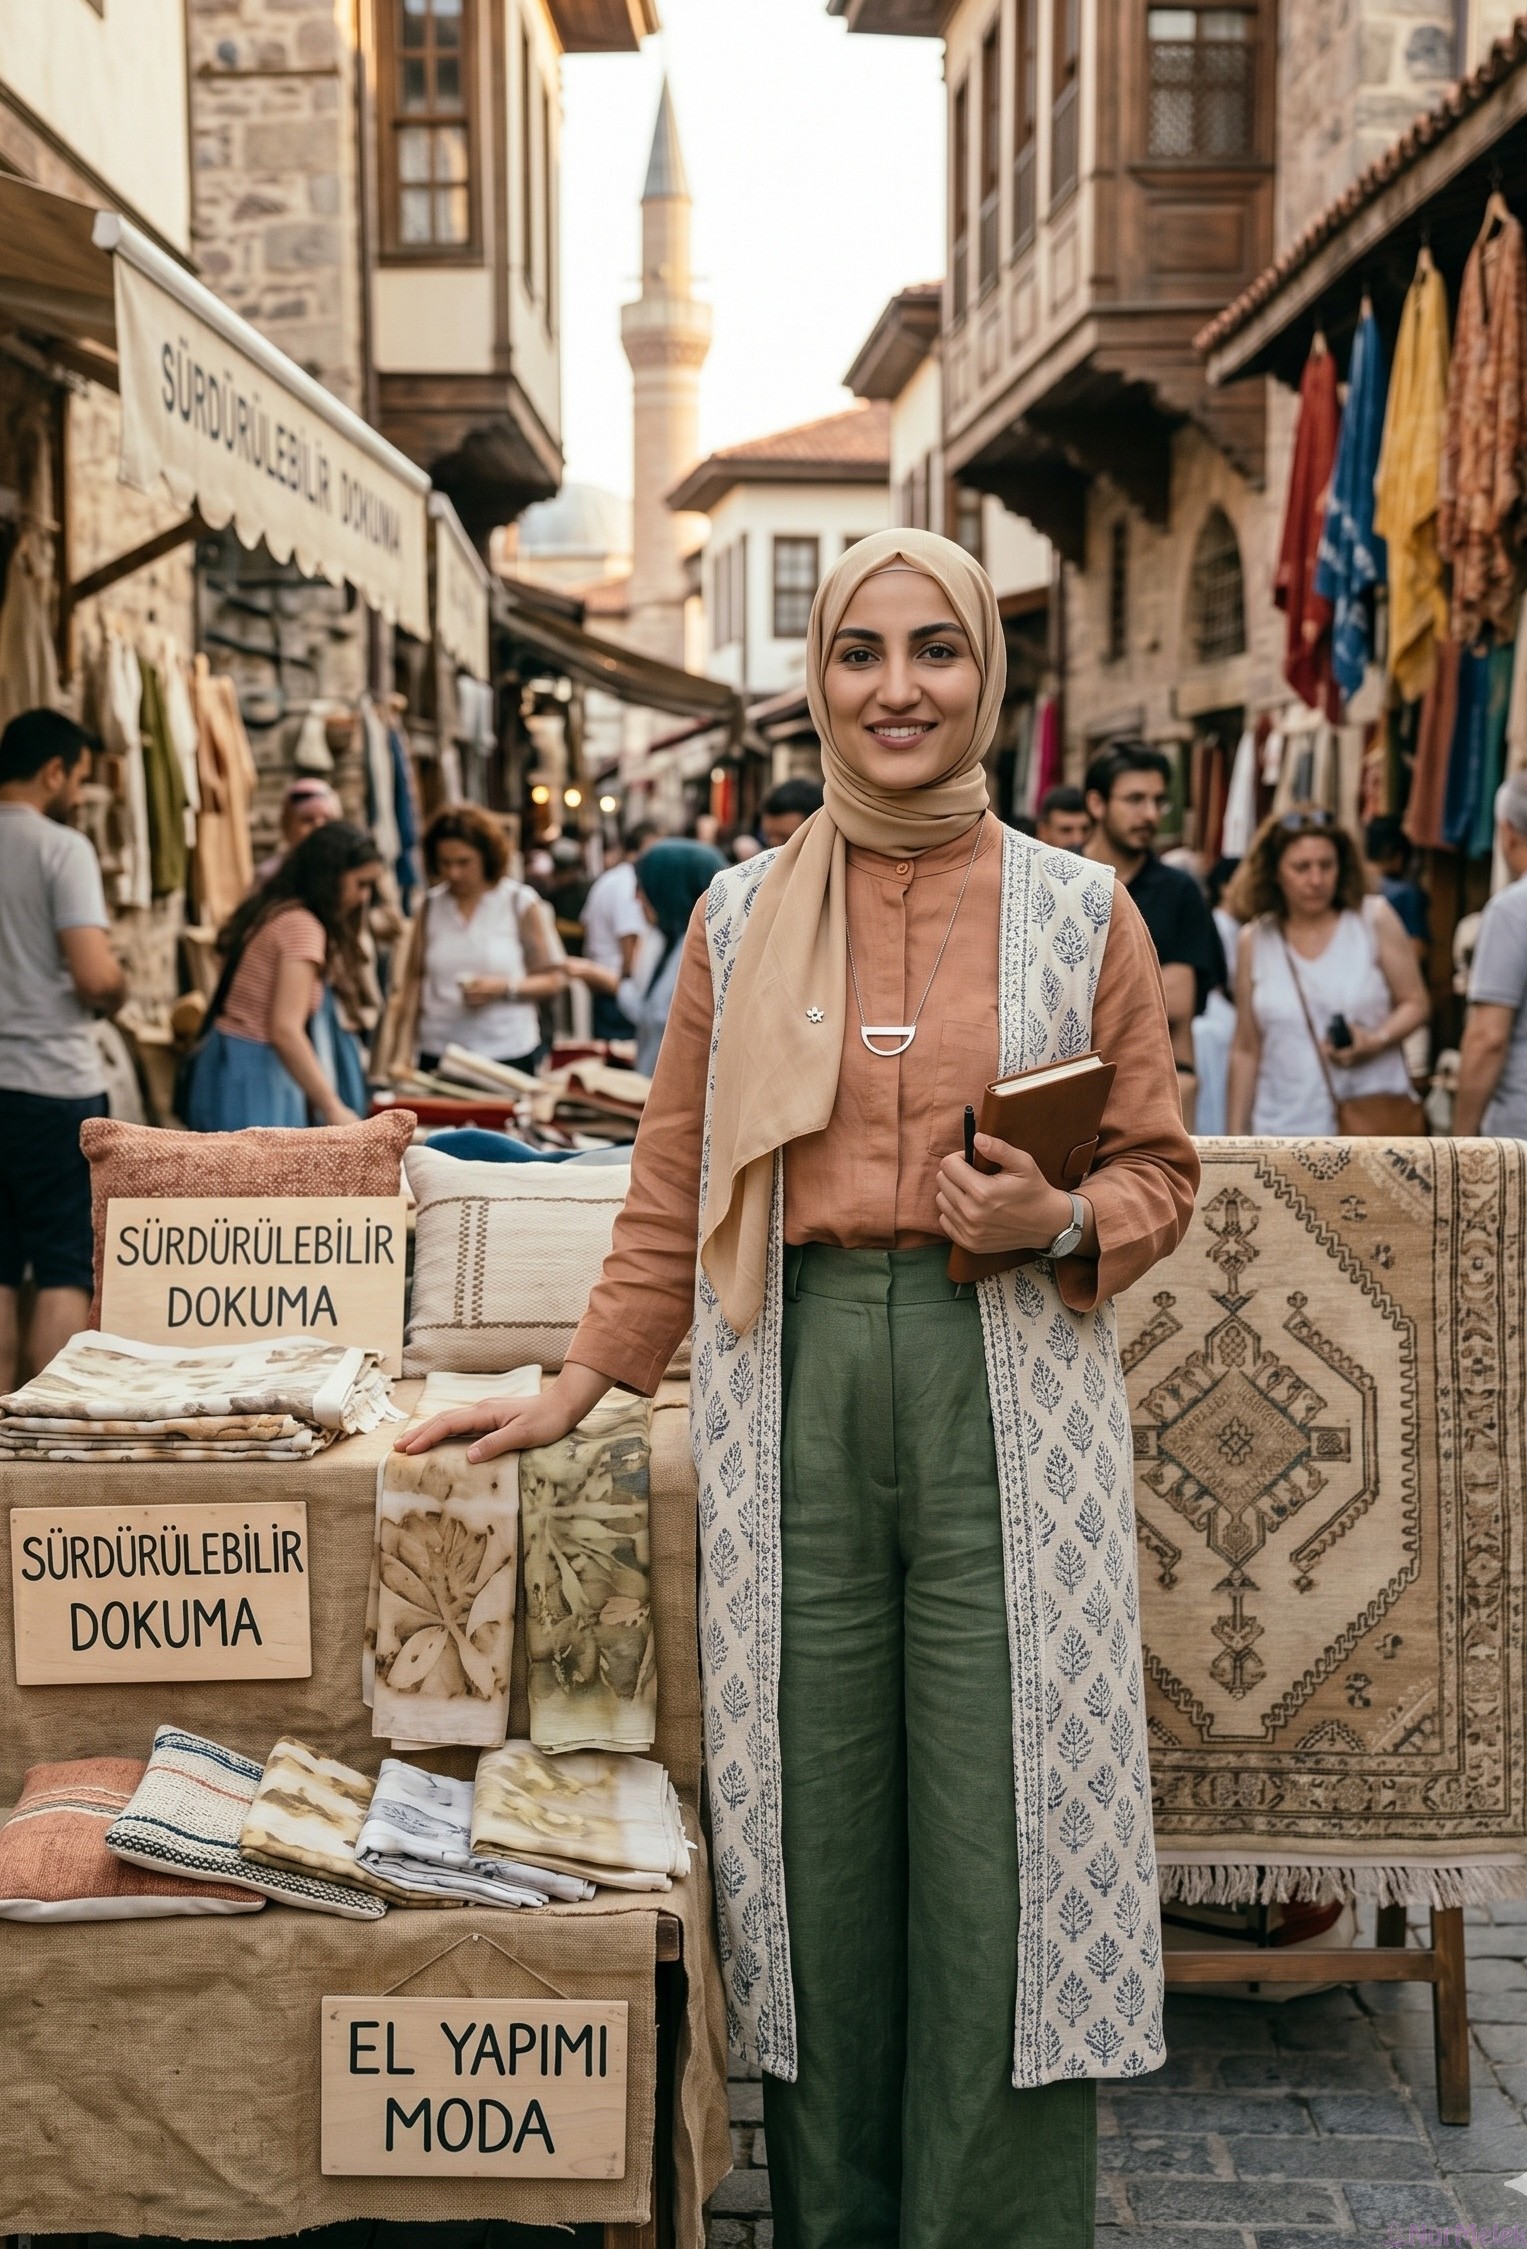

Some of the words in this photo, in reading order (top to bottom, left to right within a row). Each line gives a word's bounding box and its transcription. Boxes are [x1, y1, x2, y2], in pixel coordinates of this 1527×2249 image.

[161, 335, 332, 515] SÜRDÜRÜLEBİLİR
[116, 1217, 395, 1267] SÜRDÜRÜLEBİLİR
[167, 1285, 338, 1328] DOKUMA
[21, 1523, 304, 1582] SÜRDÜRÜLEBİLİR
[70, 1597, 263, 1651] DOKUMA
[349, 2021, 415, 2075] EL
[440, 2022, 607, 2078] YAPIMI
[385, 2097, 555, 2155] MODA
